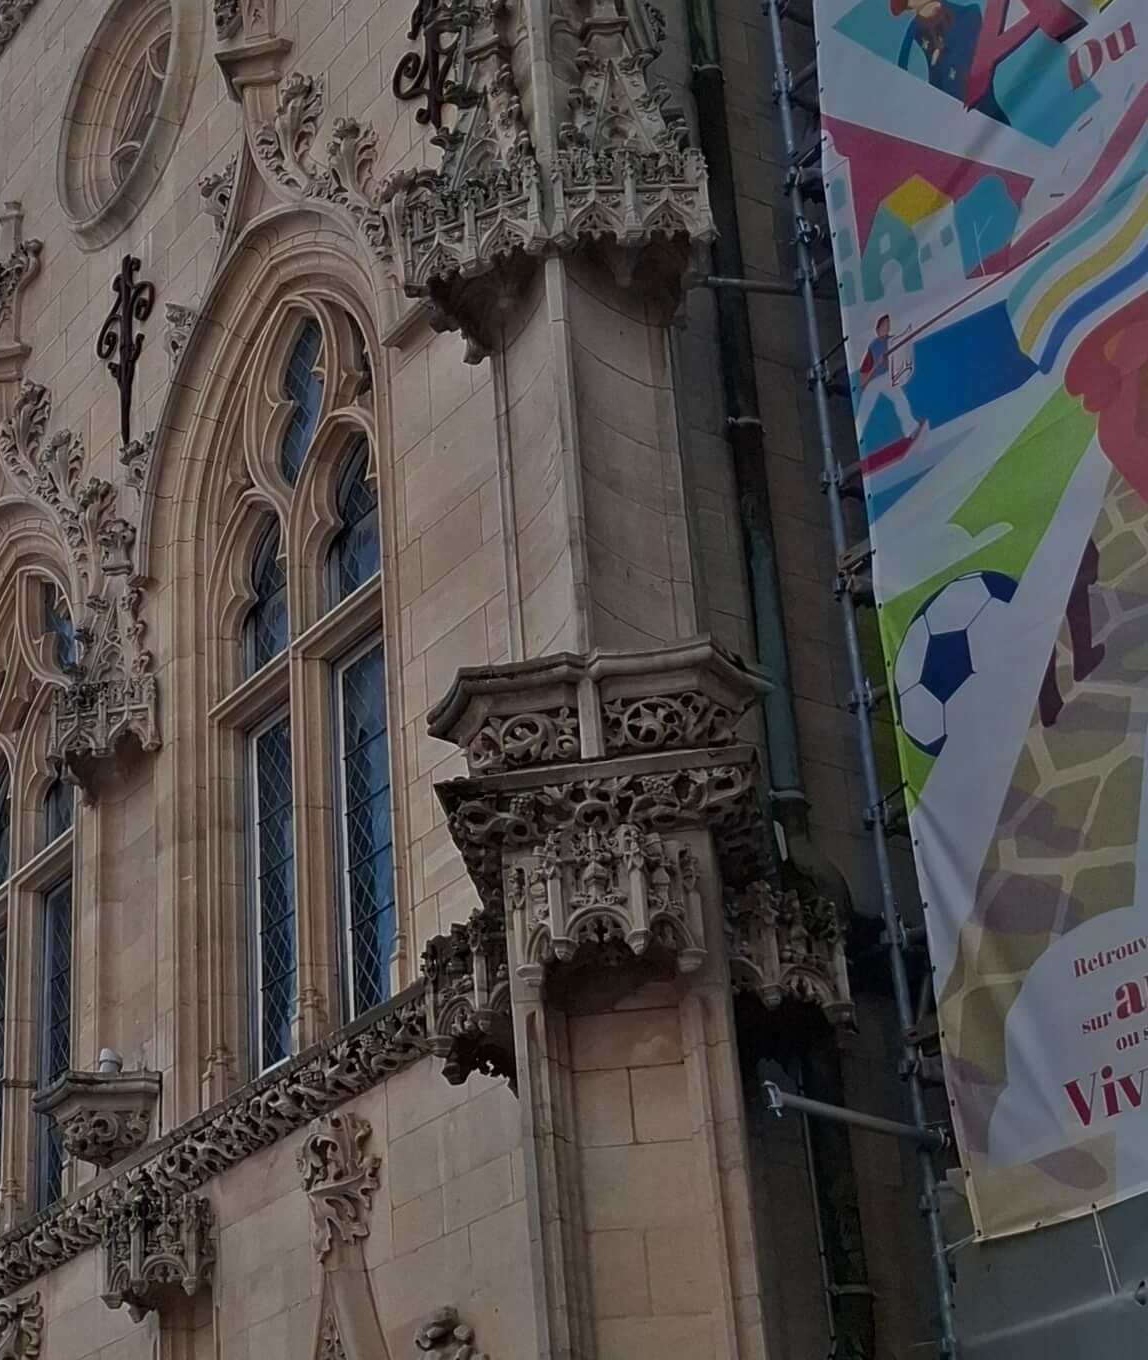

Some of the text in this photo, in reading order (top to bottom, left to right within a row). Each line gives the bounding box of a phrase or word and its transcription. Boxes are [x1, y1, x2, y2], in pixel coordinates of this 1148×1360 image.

[1082, 1011, 1112, 1034] sur
[1115, 975, 1148, 1019] a
[1116, 1031, 1139, 1050] ou
